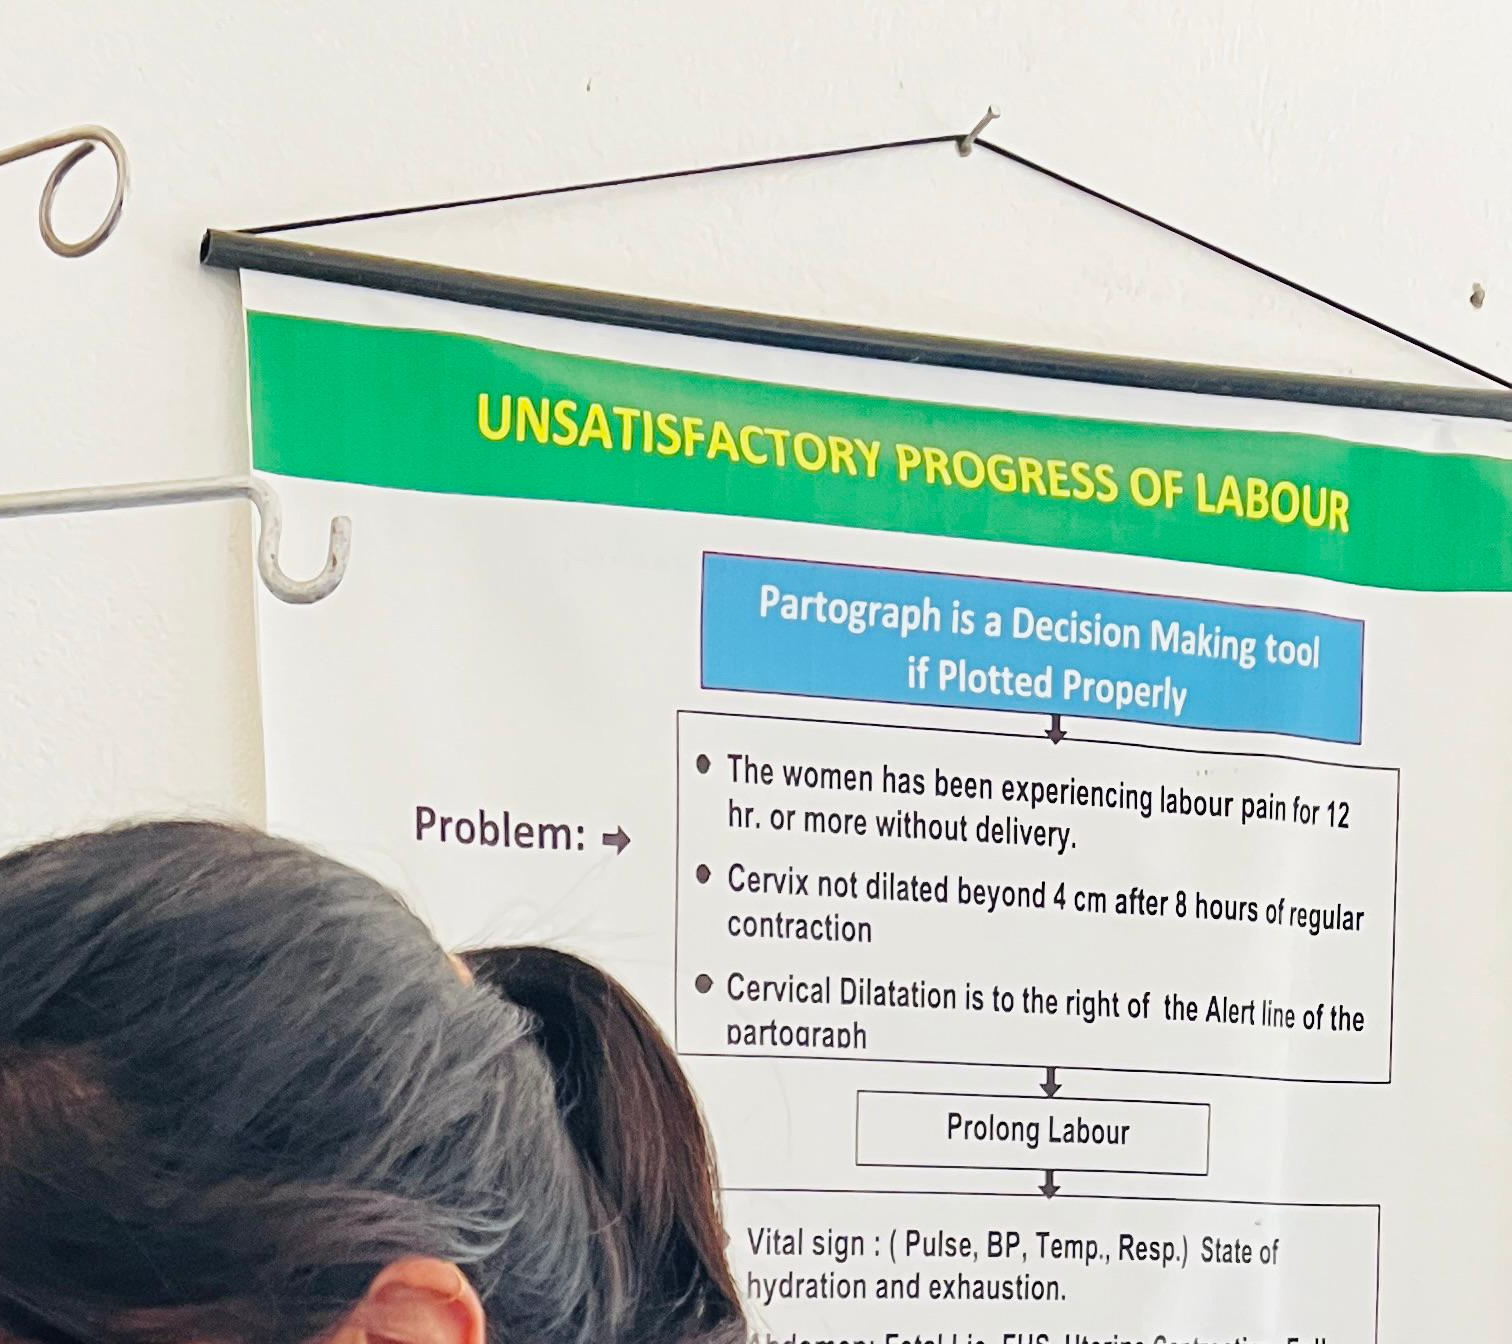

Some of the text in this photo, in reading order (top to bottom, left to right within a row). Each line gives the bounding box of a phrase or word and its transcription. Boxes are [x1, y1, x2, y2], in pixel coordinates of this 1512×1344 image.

[479, 392, 1350, 534] UNSATISFACTORY PROGRESS OF LABOUR
[760, 585, 1320, 669] Partograph is a Decision Making tool
[908, 656, 1187, 717] if Plotted Properly
[728, 754, 1349, 828] The women has been experiencing labour pain for 12
[416, 806, 584, 850] Problem:
[729, 799, 1075, 855] hr. or more without delivery.
[728, 912, 871, 942] contraction
[729, 863, 1364, 936] Cervix not dilated beyond 4 cm after 8 hours of regular
[728, 973, 1364, 1031] Cervical Dilatation is to the right of the Alert line of the
[728, 1020, 866, 1049] partograph
[948, 1113, 1130, 1149] Prolong Labour
[748, 1228, 802, 1255] Vital
[813, 1229, 863, 1263] sign
[907, 1230, 977, 1262] Pulse,
[988, 1231, 1026, 1262] BP,
[1036, 1232, 1109, 1266] Temp.,
[1119, 1234, 1187, 1267] Resp.)
[1201, 1236, 1252, 1263] State
[1260, 1239, 1279, 1264] of
[748, 1272, 1065, 1305] hydration and exhaustion.
